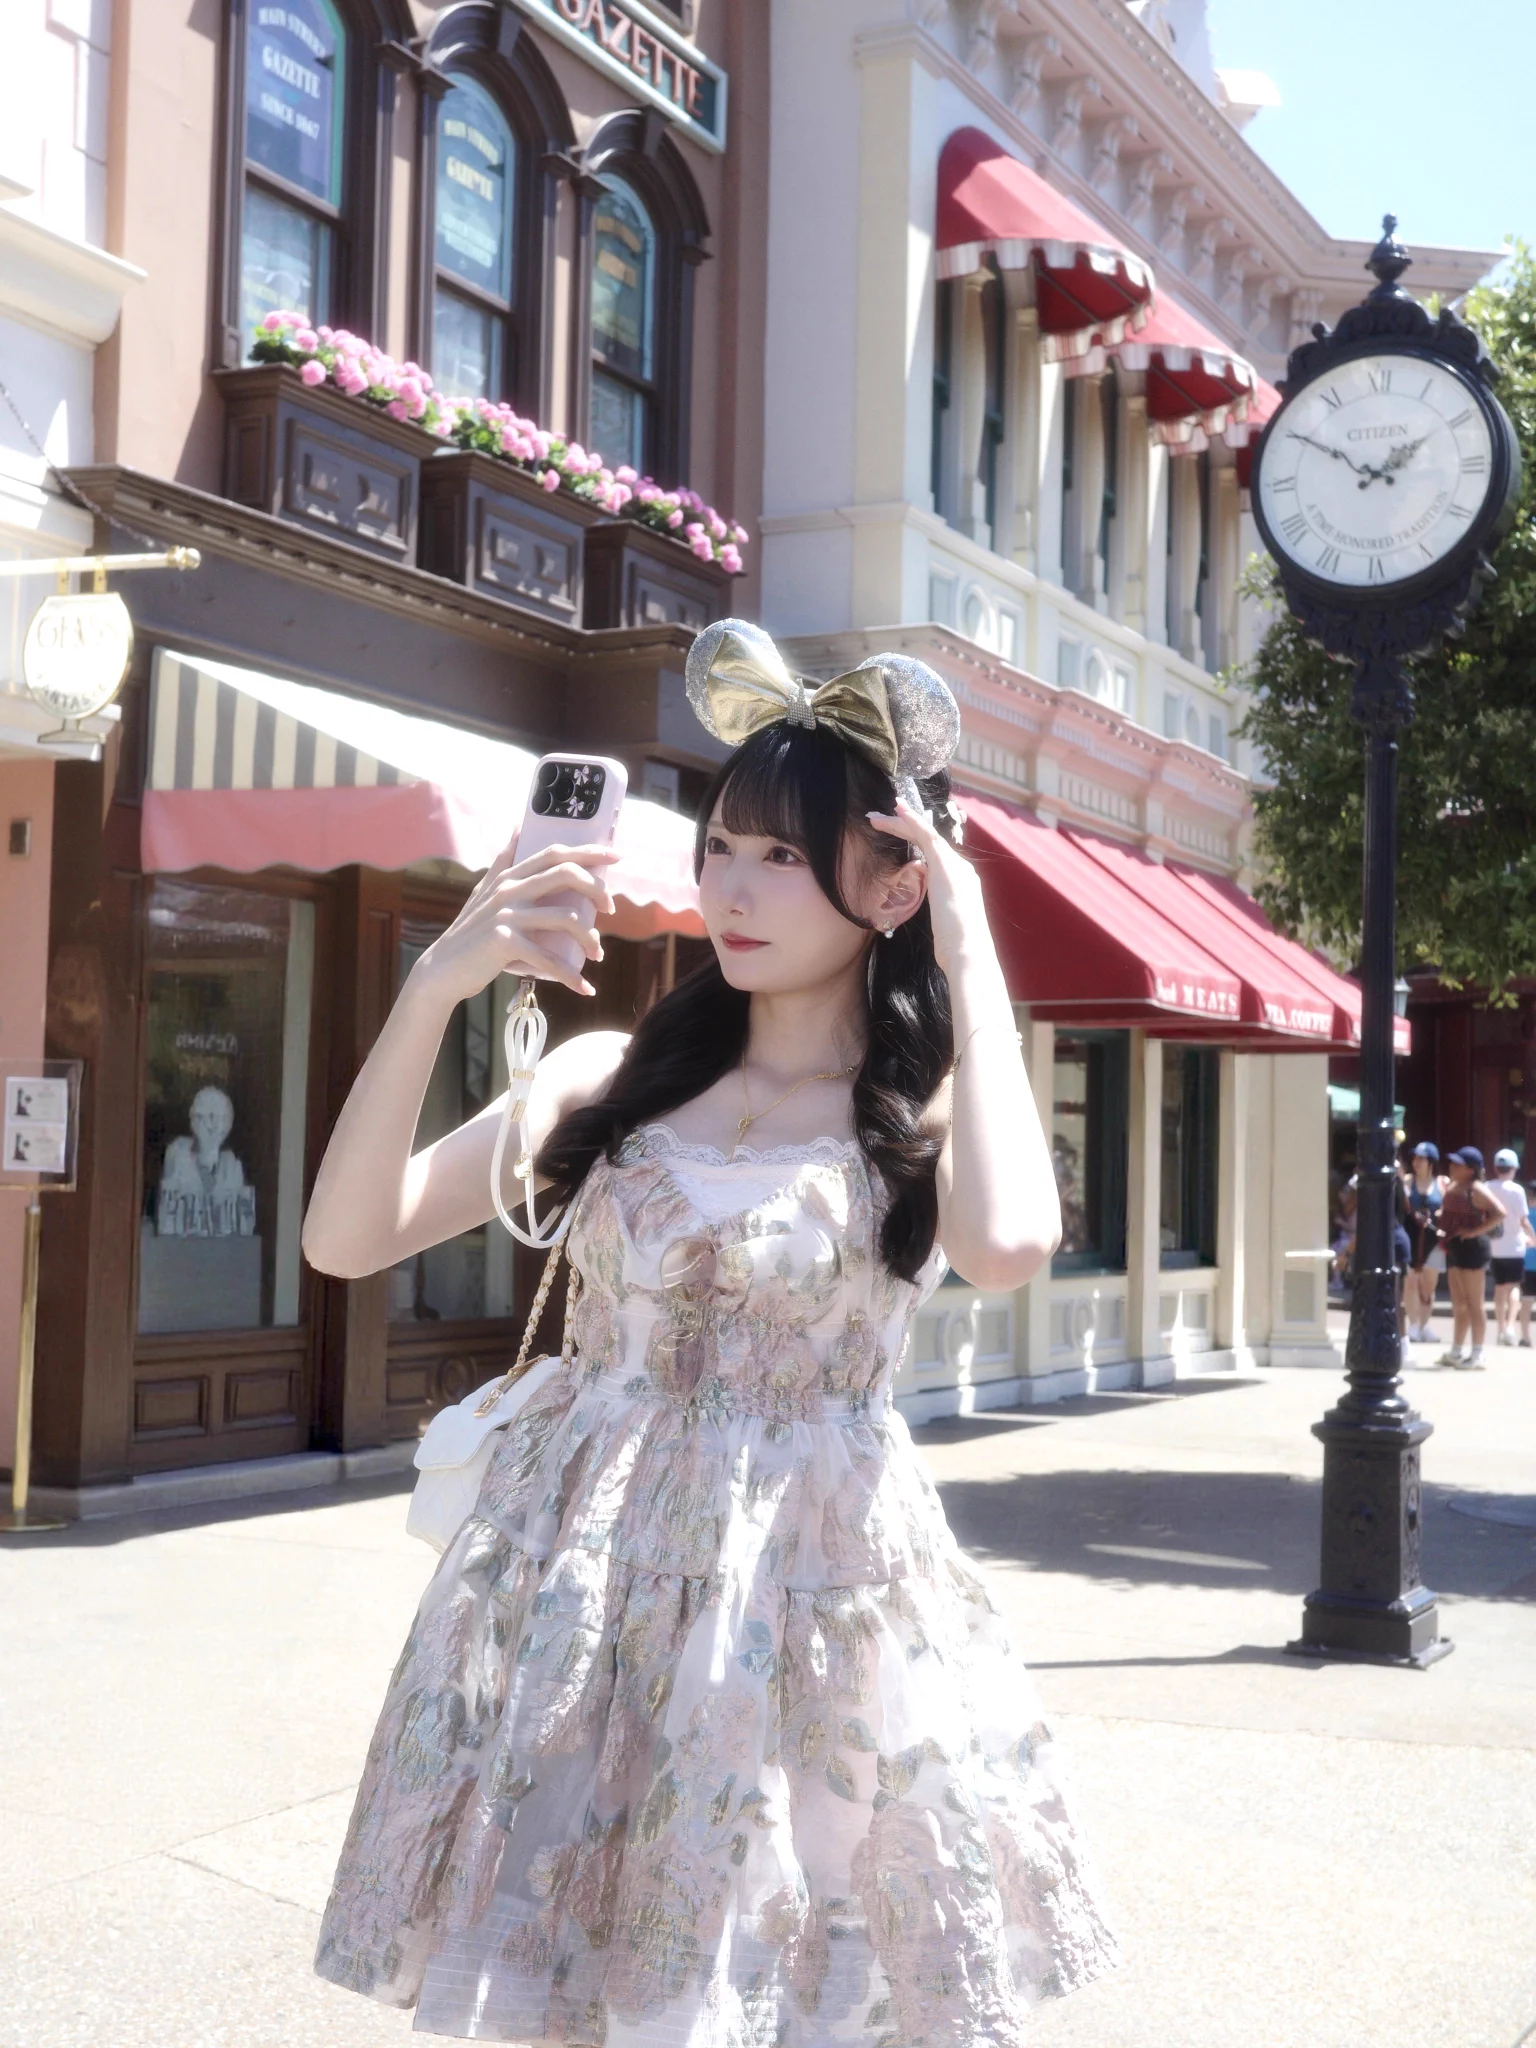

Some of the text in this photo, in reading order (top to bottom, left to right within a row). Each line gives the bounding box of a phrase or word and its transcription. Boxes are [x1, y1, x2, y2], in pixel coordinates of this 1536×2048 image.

[262, 44, 320, 100] GAZETTE
[1347, 423, 1408, 441] CITIZEN
[1397, 489, 1448, 543] TRADITION
[1182, 984, 1238, 1014] MEATS
